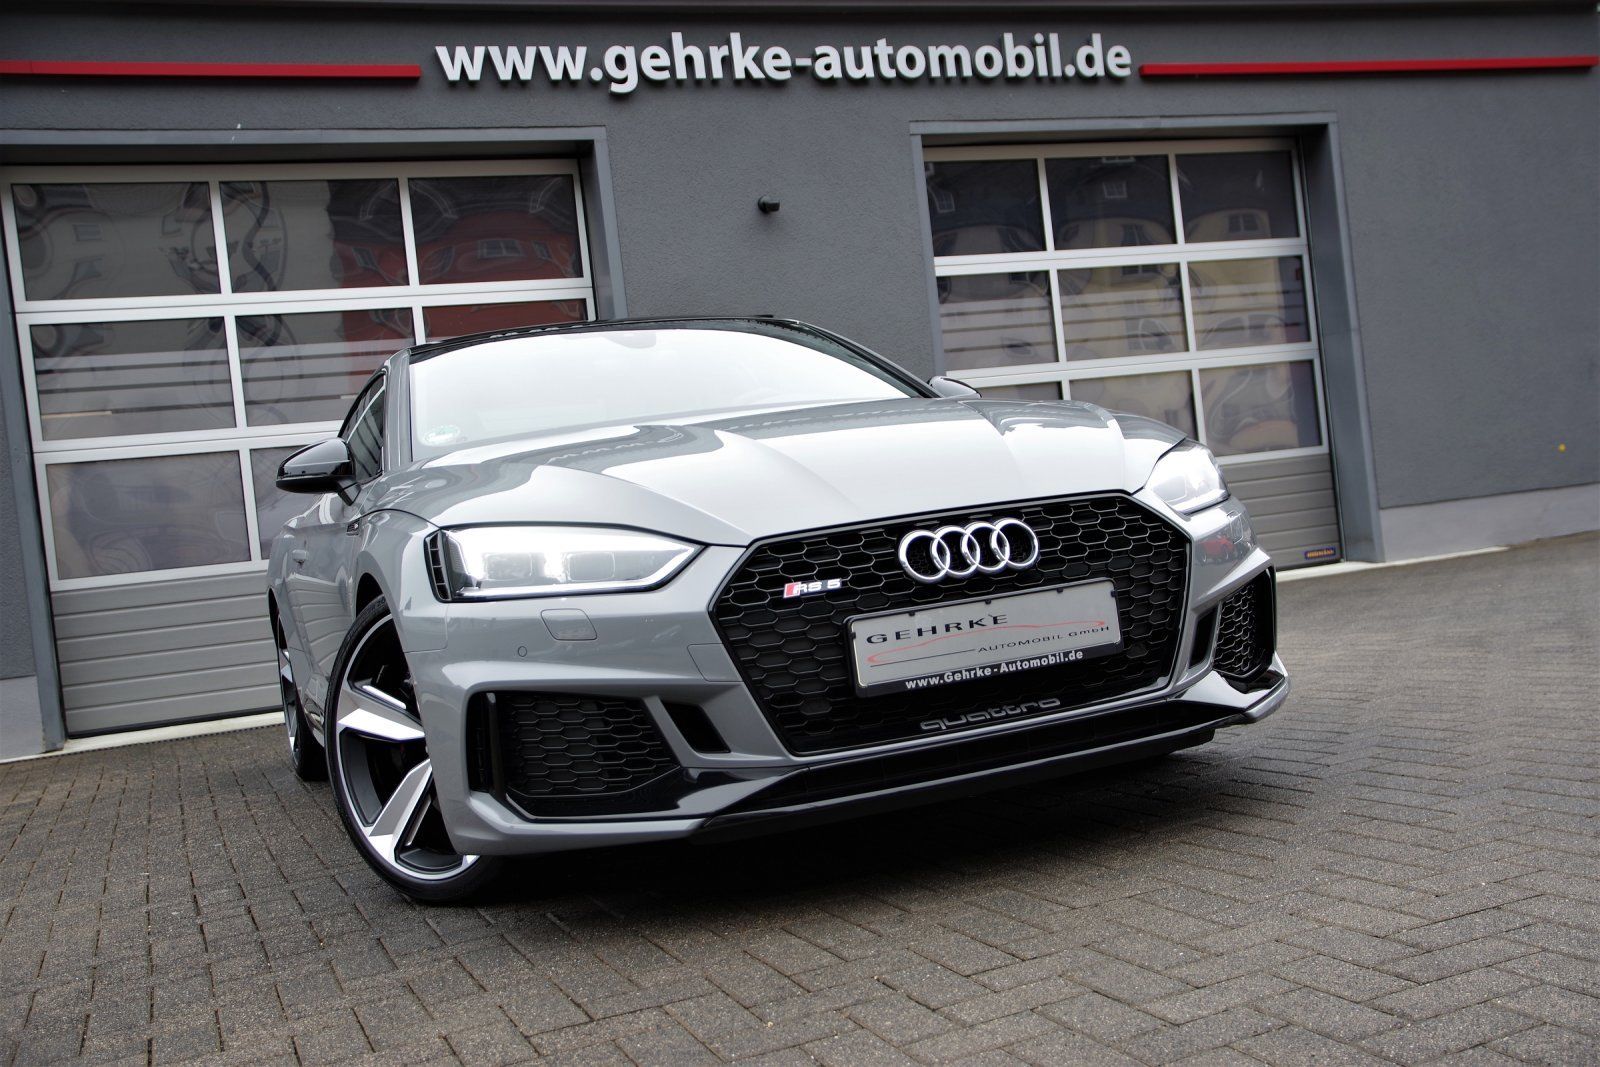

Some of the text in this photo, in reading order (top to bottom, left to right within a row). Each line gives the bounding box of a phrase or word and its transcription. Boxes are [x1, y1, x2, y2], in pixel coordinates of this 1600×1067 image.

[436, 31, 1131, 94] www.gehrke-automobil.de
[866, 614, 1008, 644] GEHRKE
[978, 626, 1110, 653] AUTOMOBIL GmbH
[920, 698, 1061, 730] quattro
